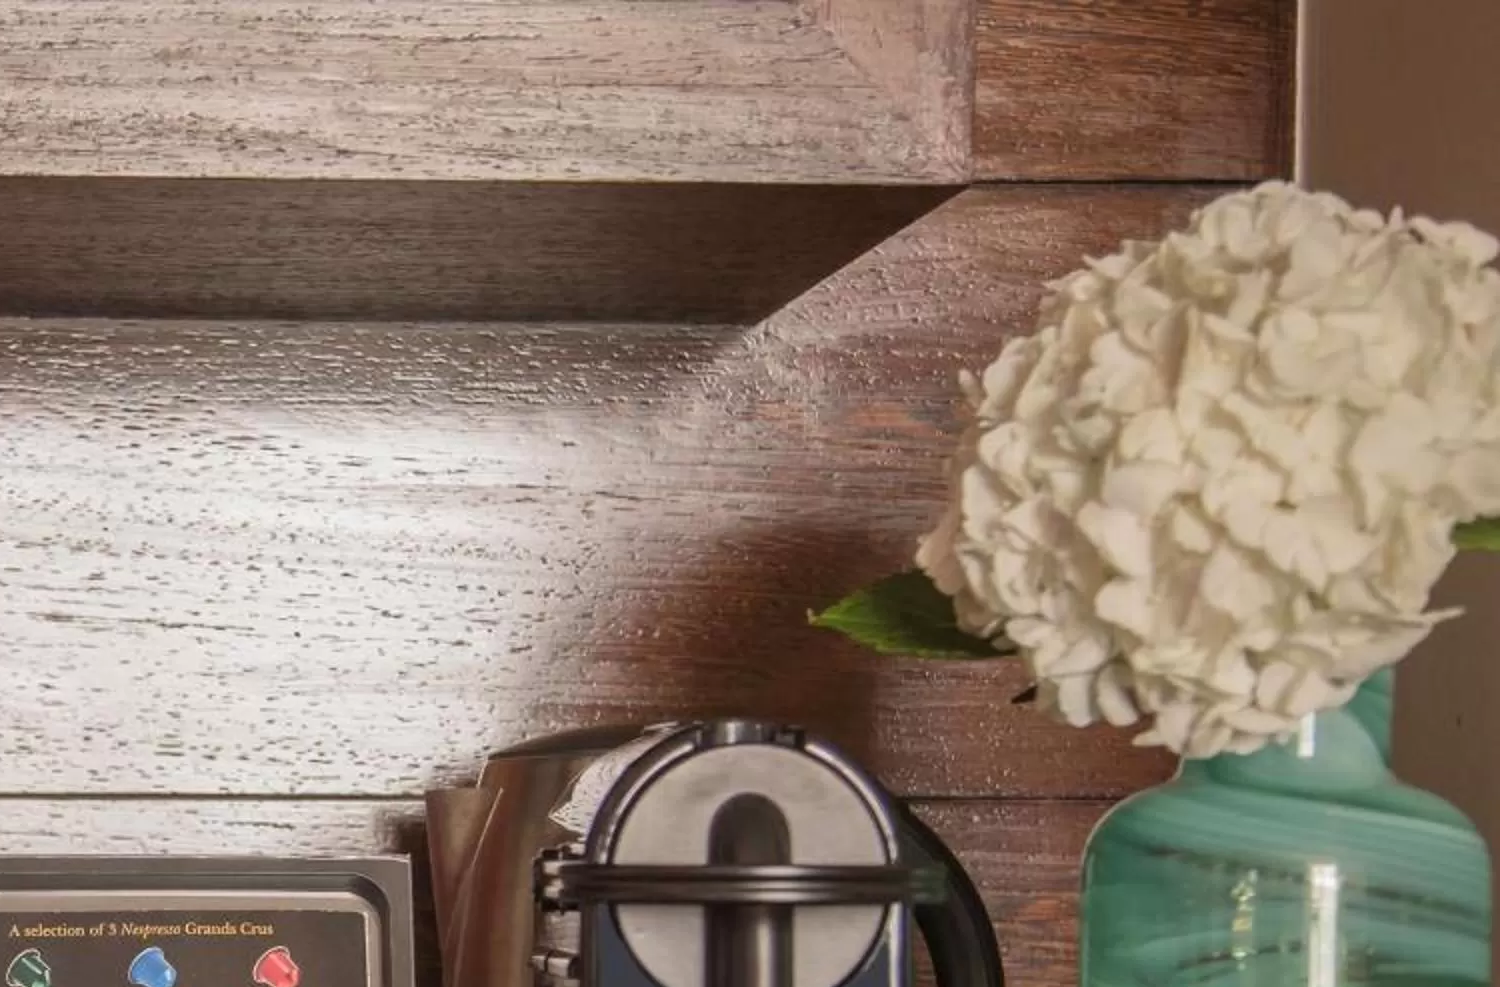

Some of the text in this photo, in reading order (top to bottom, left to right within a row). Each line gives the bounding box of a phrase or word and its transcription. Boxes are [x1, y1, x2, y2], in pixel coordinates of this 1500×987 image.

[8, 923, 21, 937] A
[24, 923, 85, 937] selection
[89, 922, 105, 937] of
[185, 921, 237, 936] Grands
[240, 921, 274, 936] Crus
